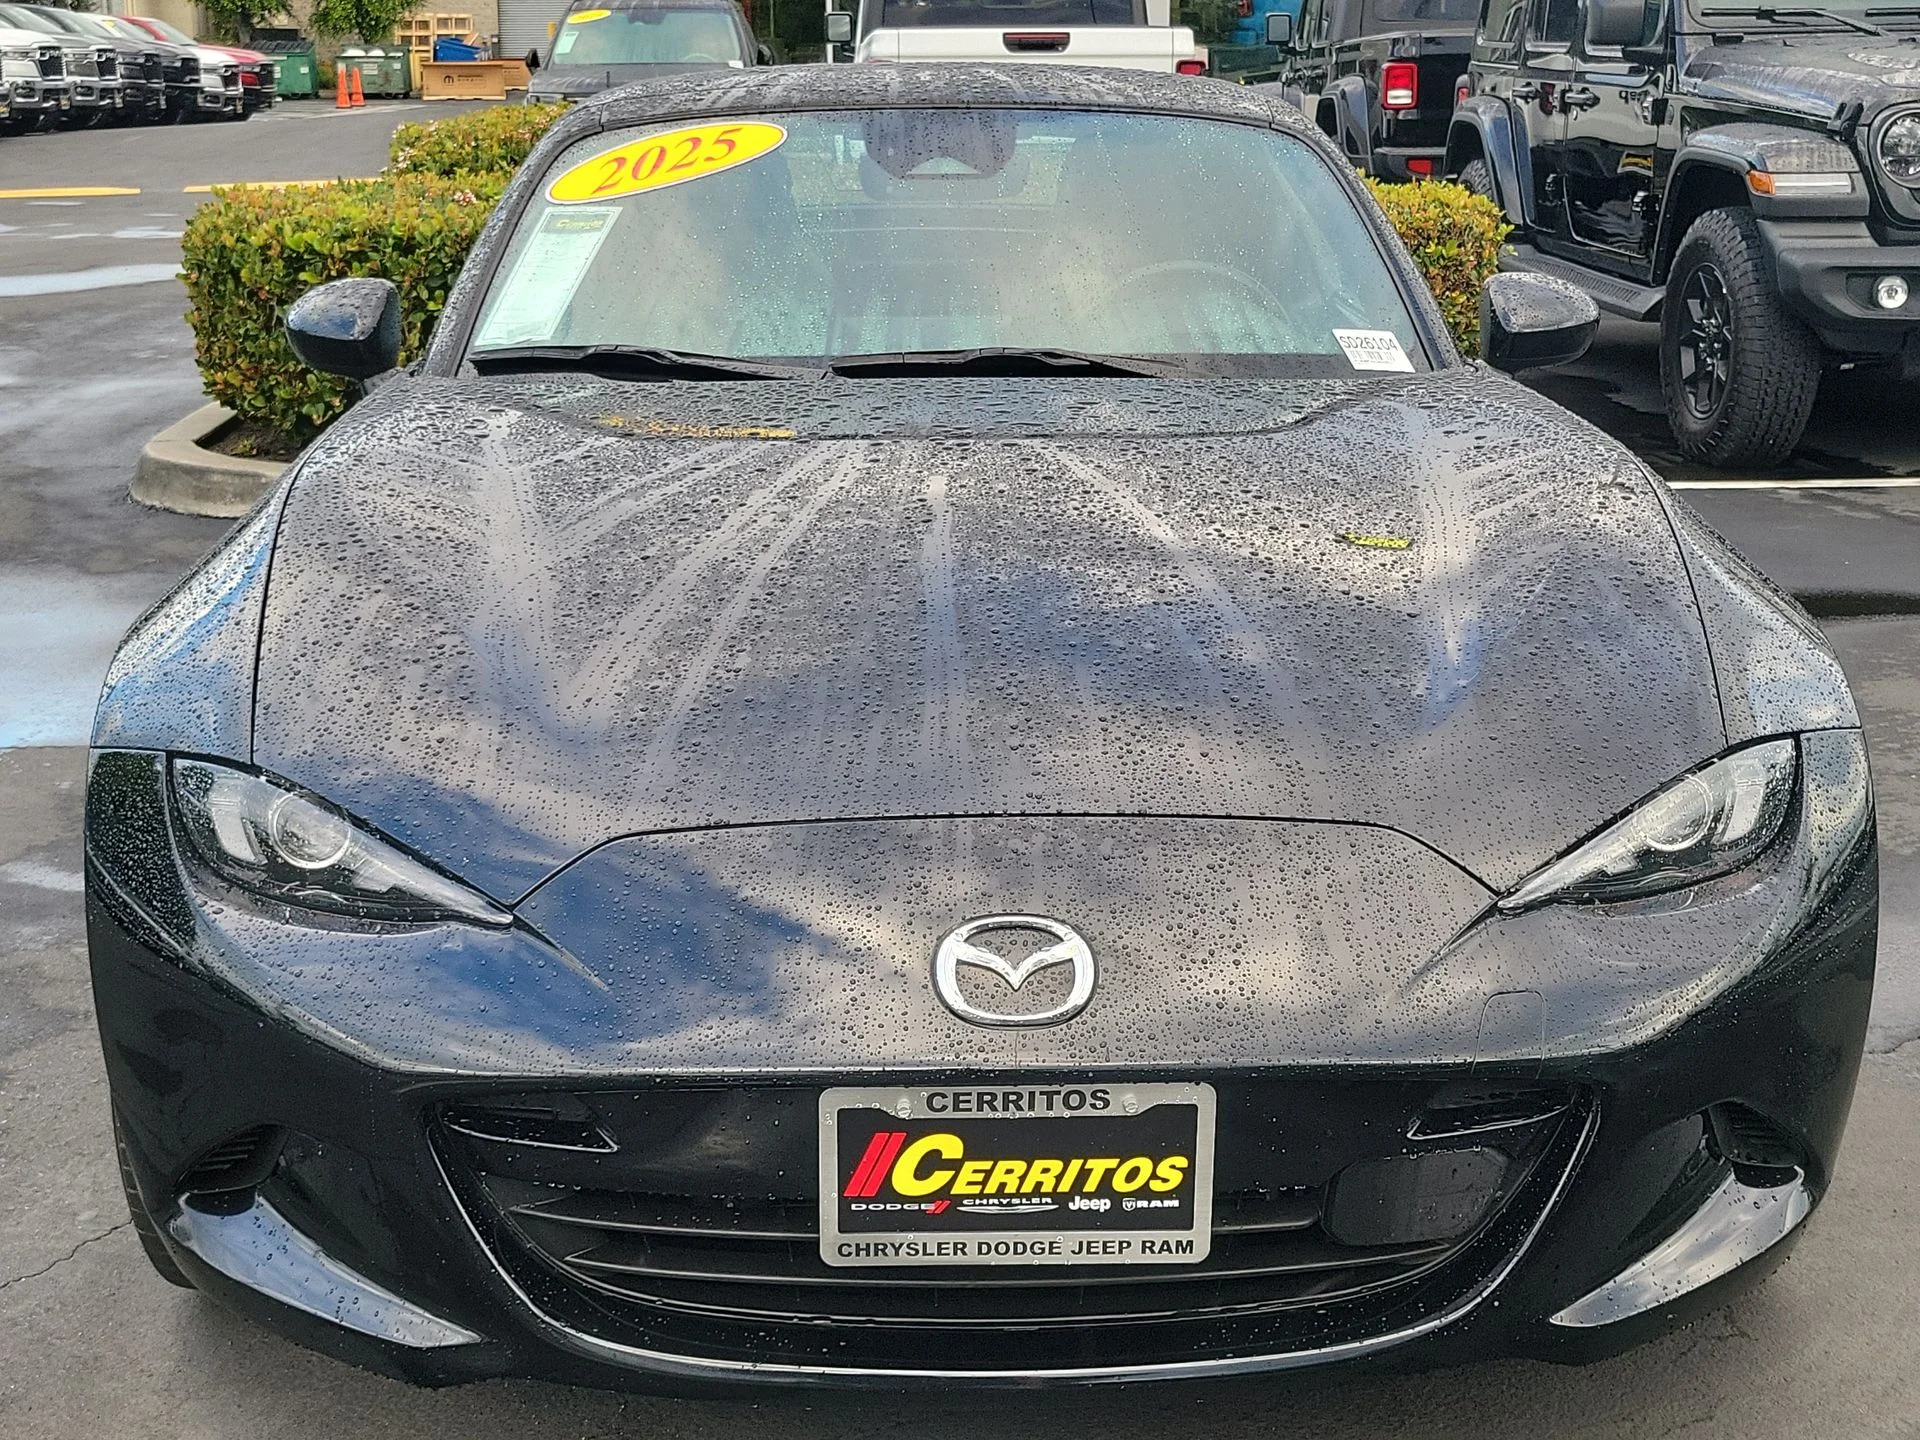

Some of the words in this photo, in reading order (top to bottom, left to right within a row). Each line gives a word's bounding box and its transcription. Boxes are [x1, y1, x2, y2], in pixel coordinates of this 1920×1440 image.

[590, 127, 743, 195] 2025
[1339, 336, 1399, 352] SD26104
[926, 1088, 1111, 1113] CERRITOS
[850, 1203, 936, 1211] DODGE
[962, 1197, 1053, 1206] CHRYSLER
[1068, 1195, 1112, 1213] Jeep
[1136, 1199, 1180, 1208] RAM
[837, 1241, 968, 1258] CHRYSLER
[977, 1240, 1063, 1256] DODGE
[1070, 1240, 1132, 1255] JEEP
[1141, 1239, 1194, 1255] RAM
